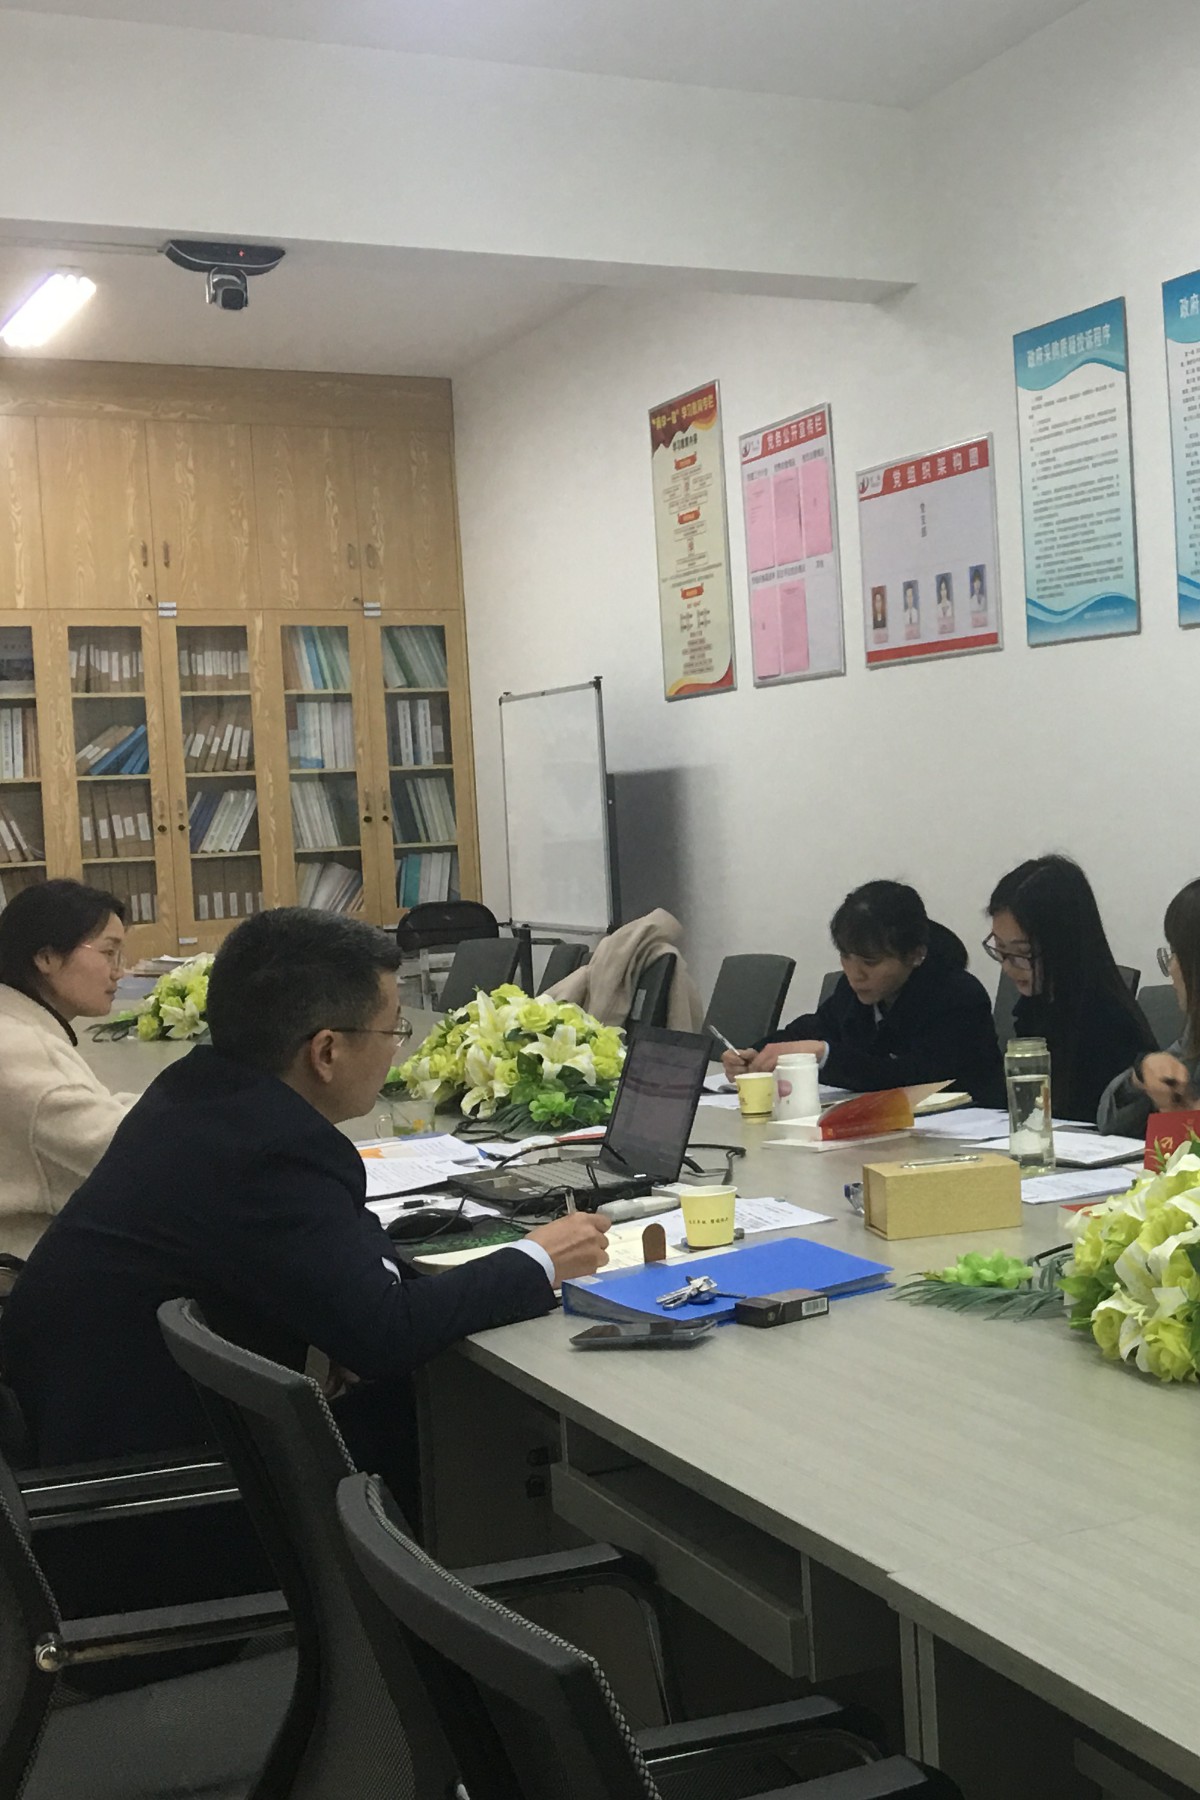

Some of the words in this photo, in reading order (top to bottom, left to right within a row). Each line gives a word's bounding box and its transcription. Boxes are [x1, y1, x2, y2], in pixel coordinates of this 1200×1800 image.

[1026, 323, 1111, 369] 政府采购质疑投诉程序
[892, 447, 979, 489] 党组织架构图
